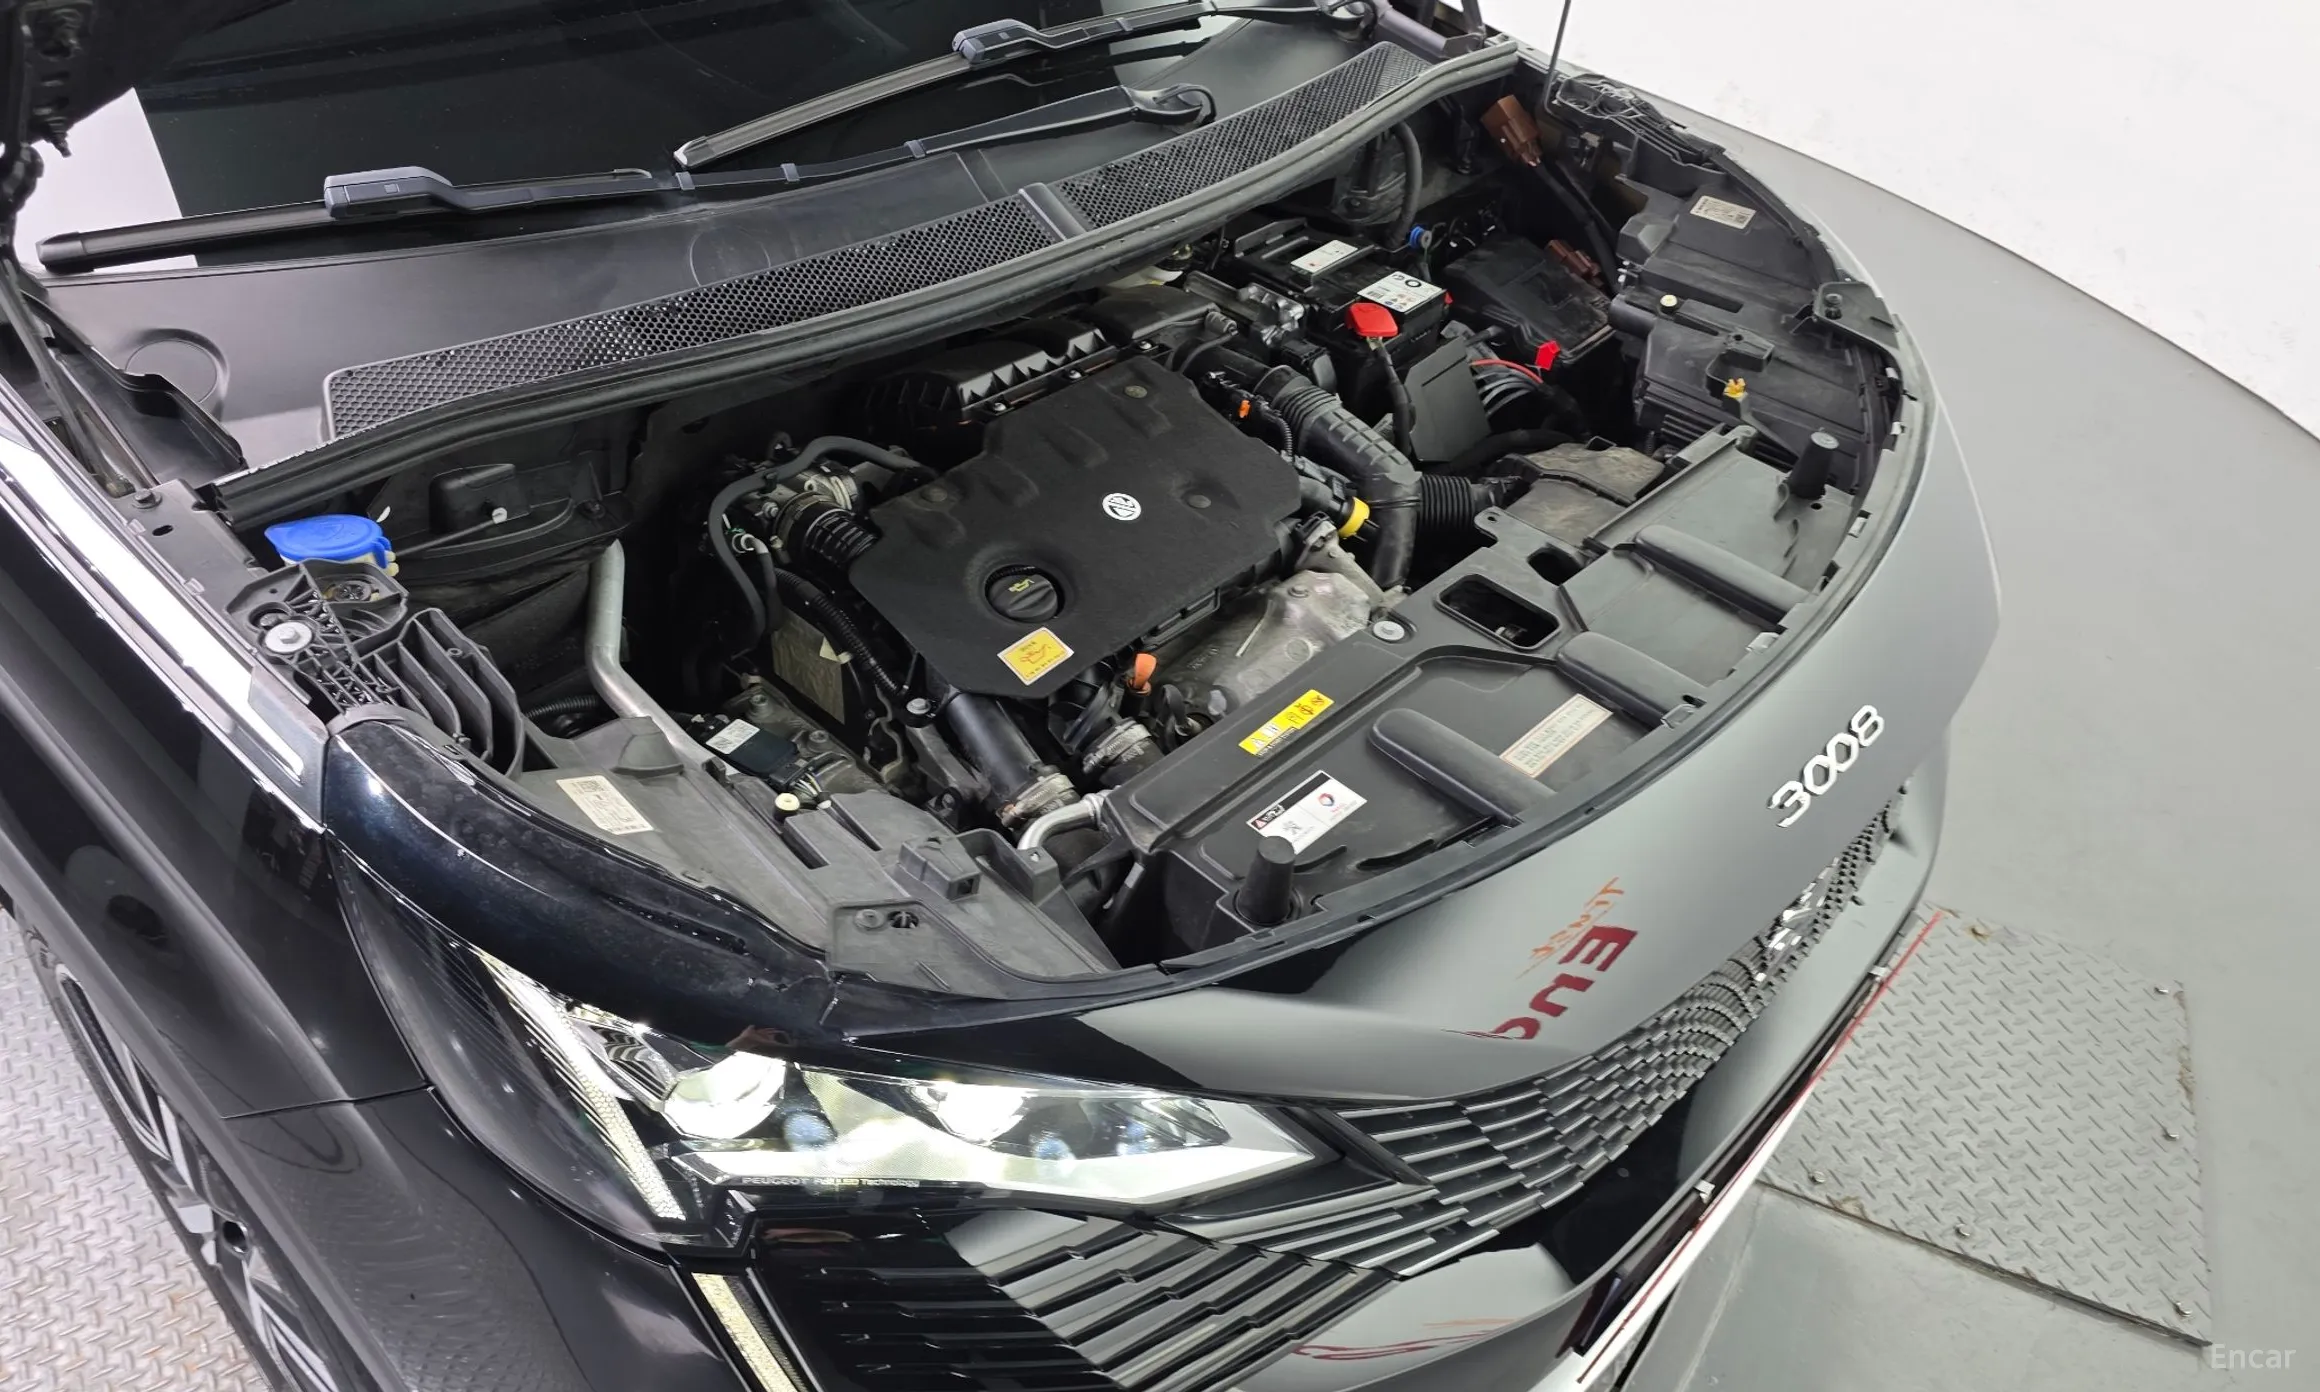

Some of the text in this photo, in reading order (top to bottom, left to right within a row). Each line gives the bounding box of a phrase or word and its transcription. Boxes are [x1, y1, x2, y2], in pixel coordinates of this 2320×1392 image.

[1767, 704, 1885, 828] 3008
[742, 1177, 810, 1186] PEUGEOT
[860, 1178, 920, 1187] Technology
